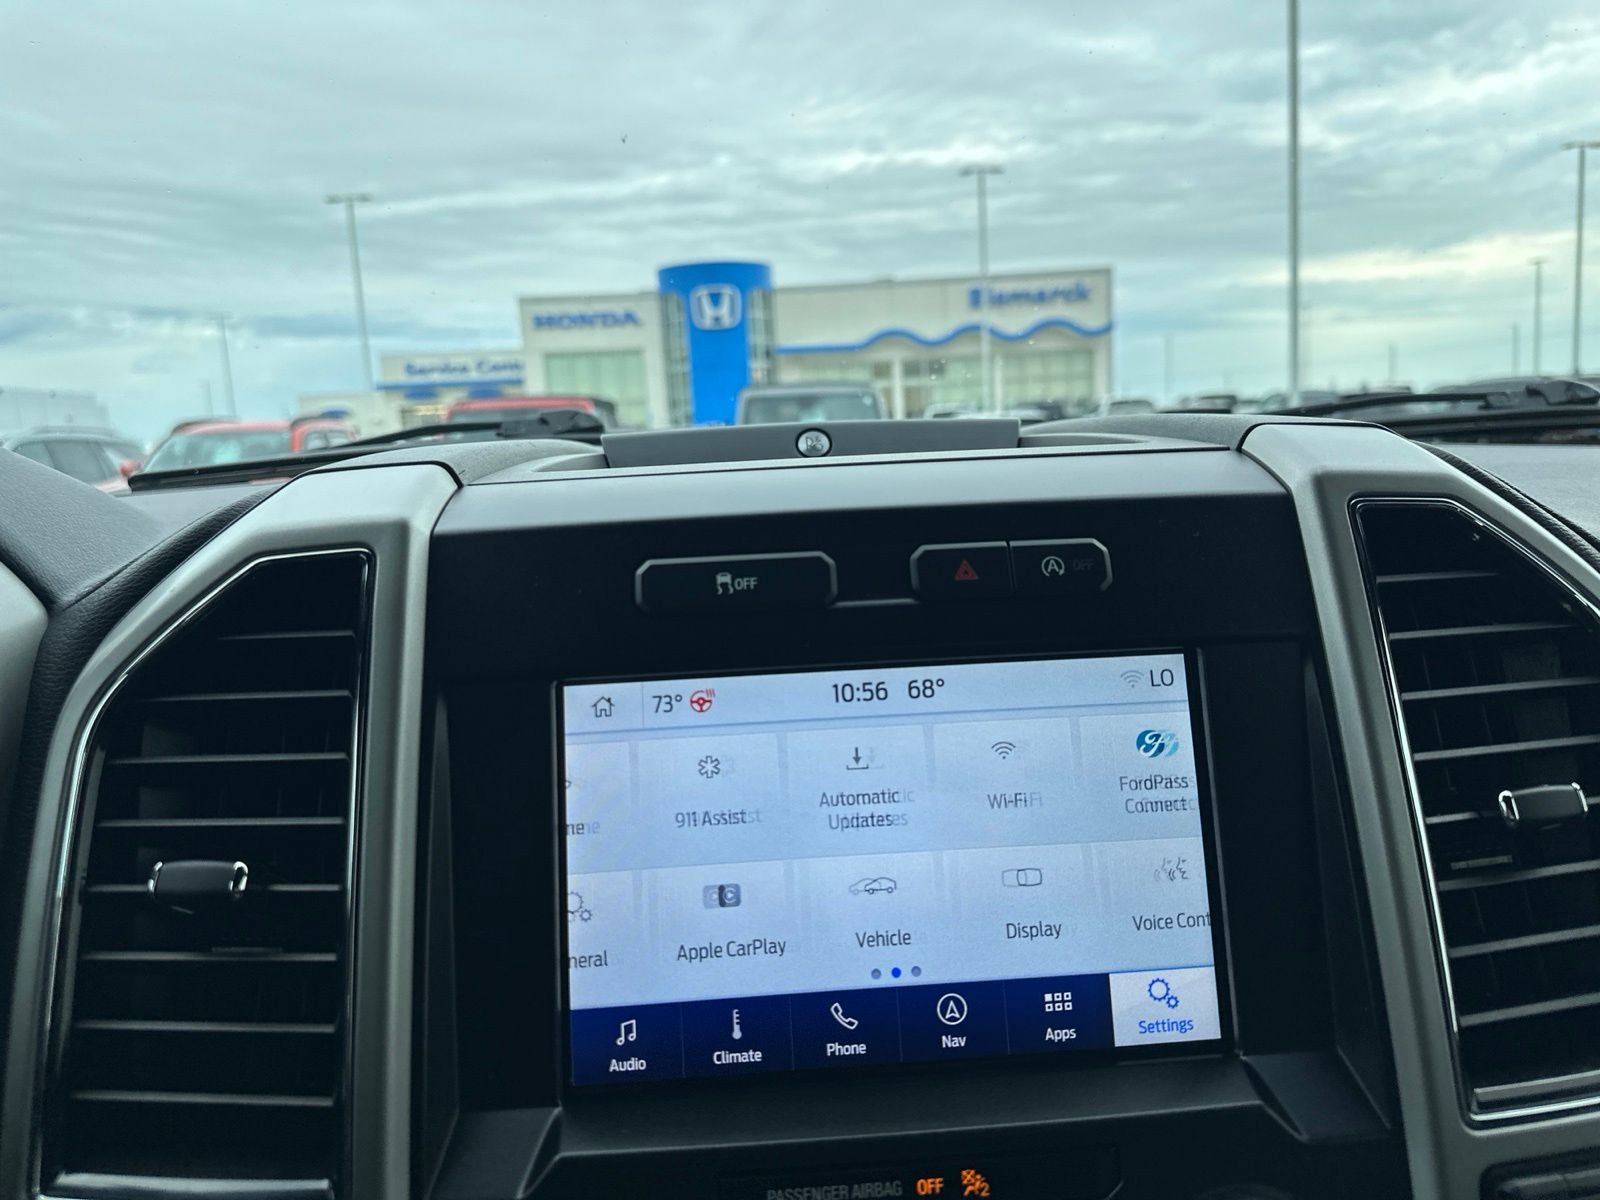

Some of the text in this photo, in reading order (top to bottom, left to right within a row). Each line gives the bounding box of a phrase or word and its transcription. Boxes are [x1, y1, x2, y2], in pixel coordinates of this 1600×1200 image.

[532, 310, 641, 330] HONDA
[734, 576, 758, 592] OFF
[1150, 668, 1175, 687] LO
[832, 678, 945, 704] 10:56 68°
[652, 693, 683, 713] 73°
[1119, 774, 1190, 791] FordPass
[819, 788, 900, 808] Automatic
[987, 791, 1029, 809] Wi-Fi
[1125, 796, 1189, 814] Connect
[675, 808, 747, 828] 911 Assist
[828, 812, 894, 832] Updates
[1006, 921, 1062, 941] Display
[1132, 913, 1174, 931] Voice
[855, 928, 912, 948] Vehicle
[677, 939, 787, 963] Apple CarPlay
[1045, 1026, 1077, 1042] Apps
[1138, 1018, 1194, 1034] Settings
[826, 1042, 867, 1056] Phone
[942, 1035, 967, 1048] Nav
[609, 1057, 647, 1073] Audio
[713, 1049, 763, 1065] Climate
[766, 1184, 849, 1200] PASSENGER
[851, 1180, 903, 1200] AIRBAG
[916, 1177, 945, 1195] OFF
